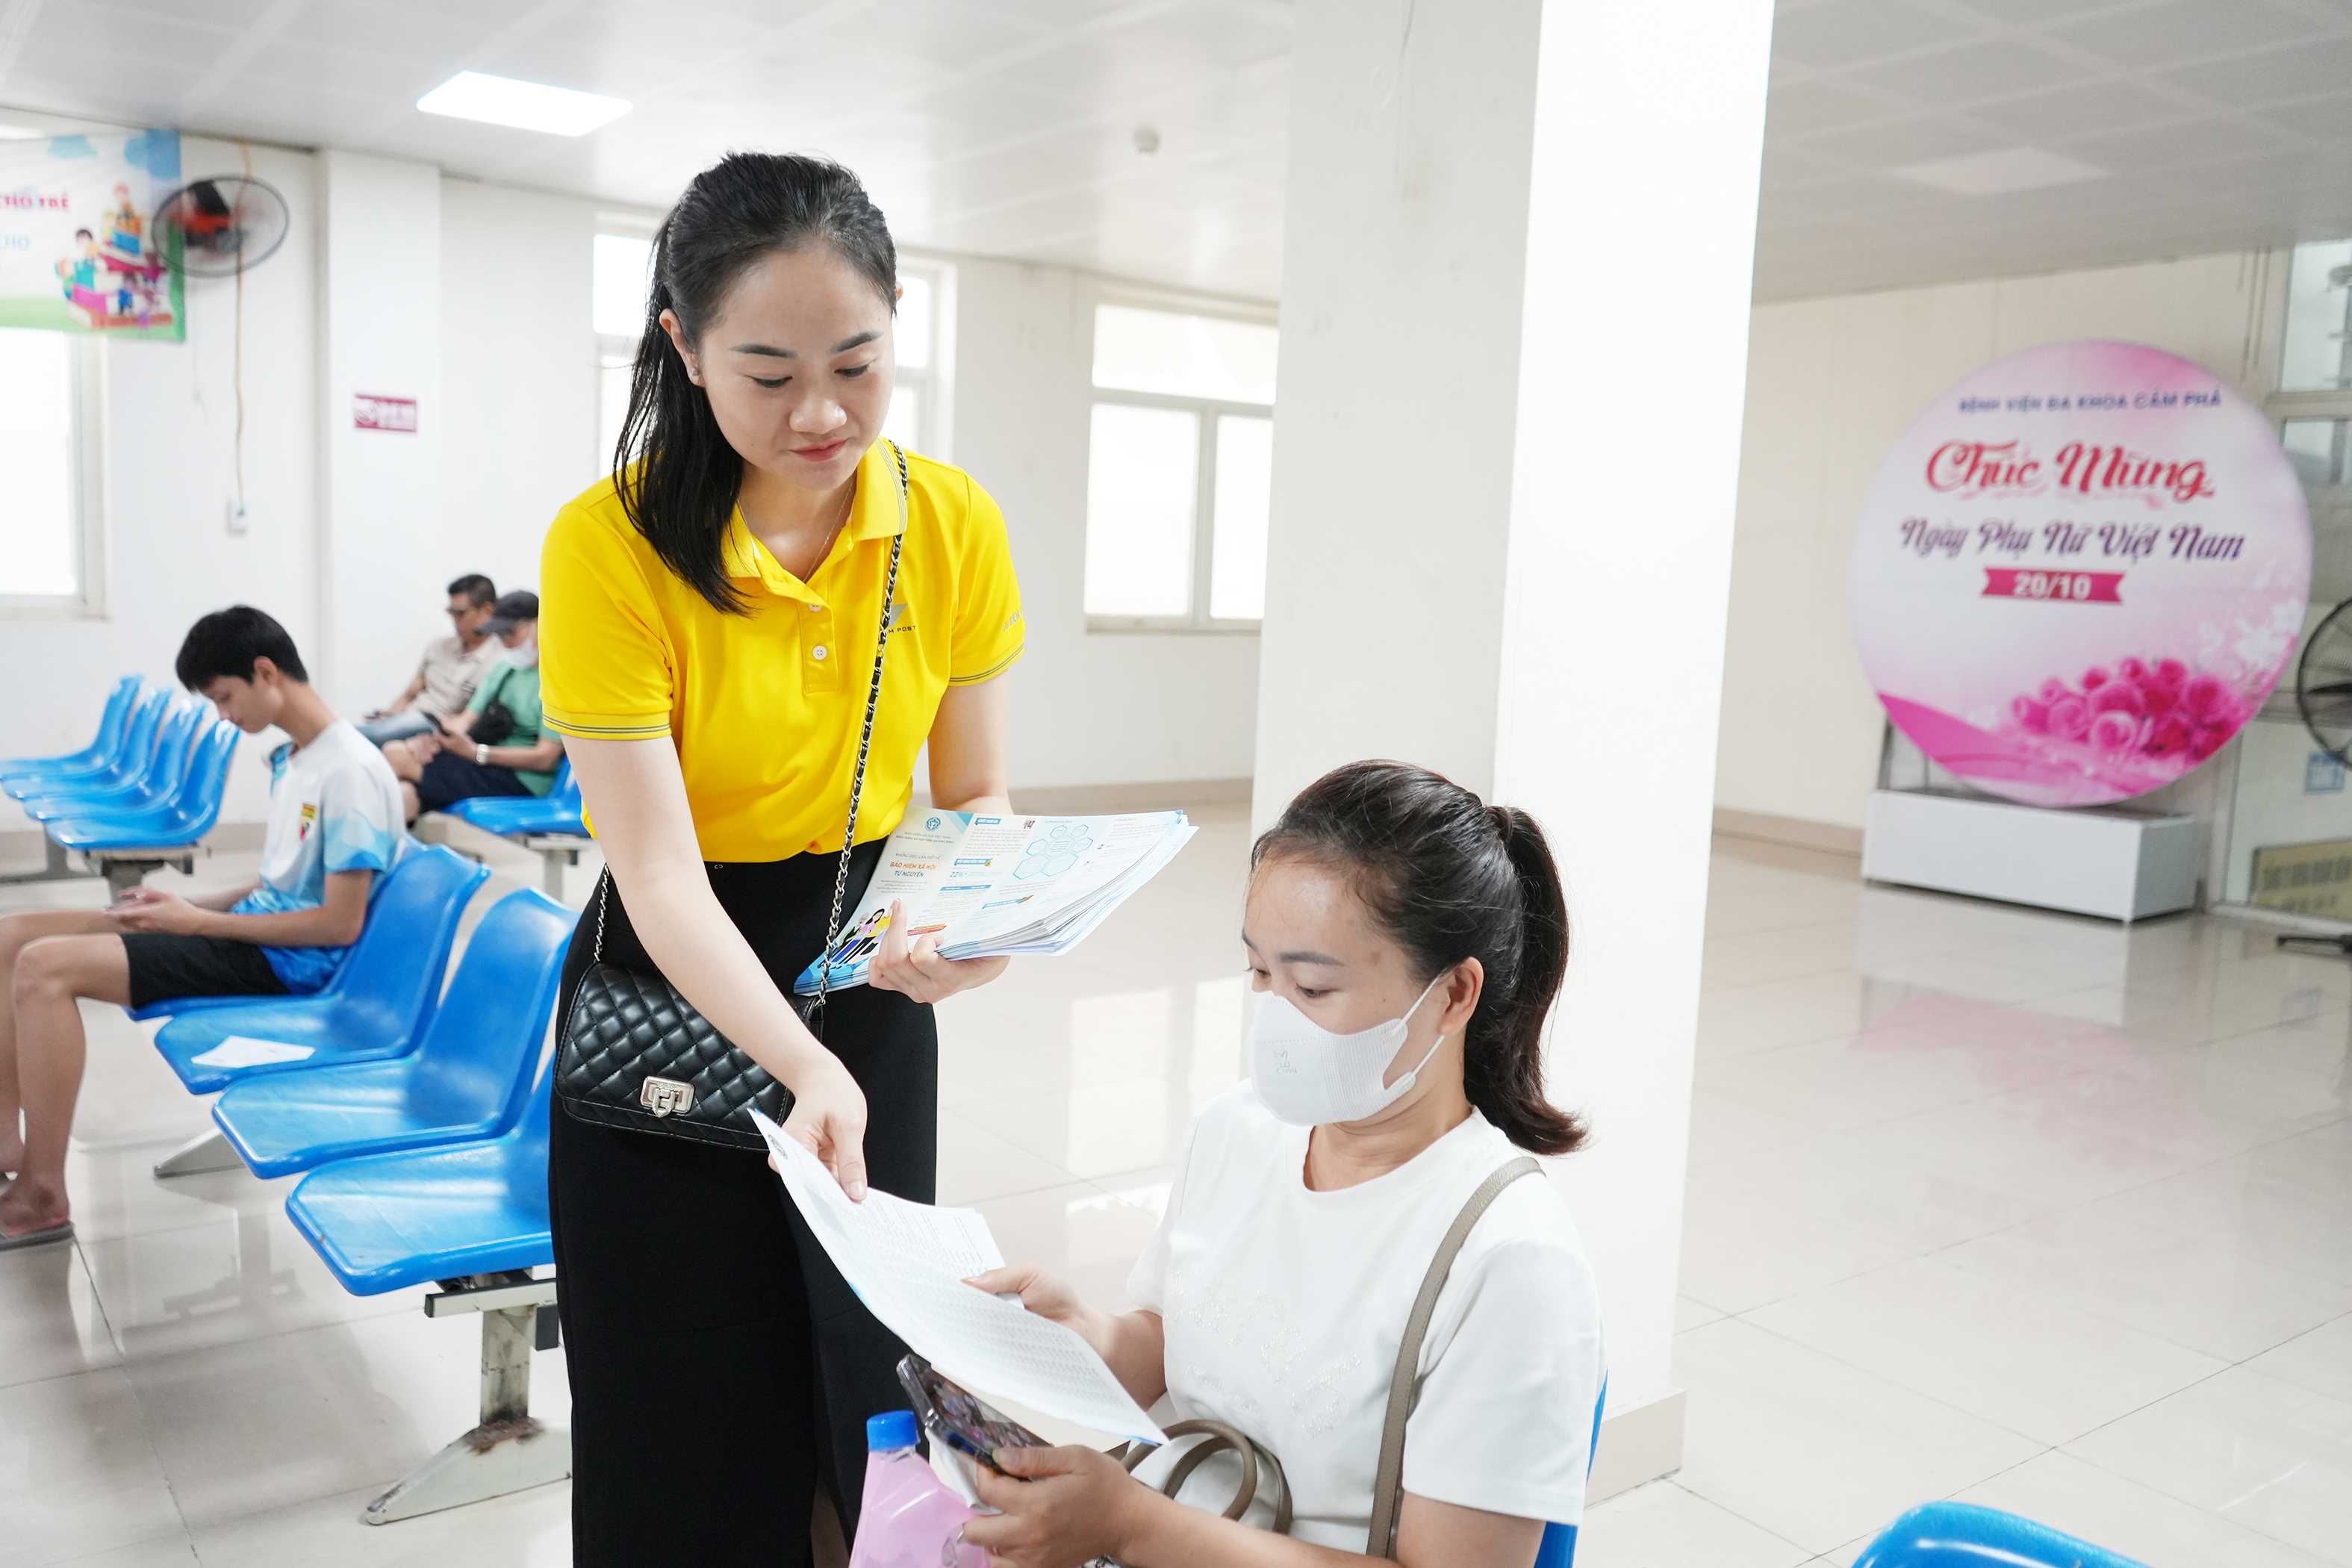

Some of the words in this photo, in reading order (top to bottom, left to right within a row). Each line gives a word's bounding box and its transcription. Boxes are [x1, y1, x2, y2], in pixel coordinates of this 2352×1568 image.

[2078, 393, 2127, 409] KHOA
[1926, 439, 2040, 493] Chúc
[1901, 517, 1968, 558] Ngày
[1977, 519, 2032, 559] Phụ
[2044, 519, 2093, 556] Nữ
[2099, 520, 2162, 564] Việt
[2169, 524, 2246, 562] Nam
[2013, 571, 2092, 600] 20/10
